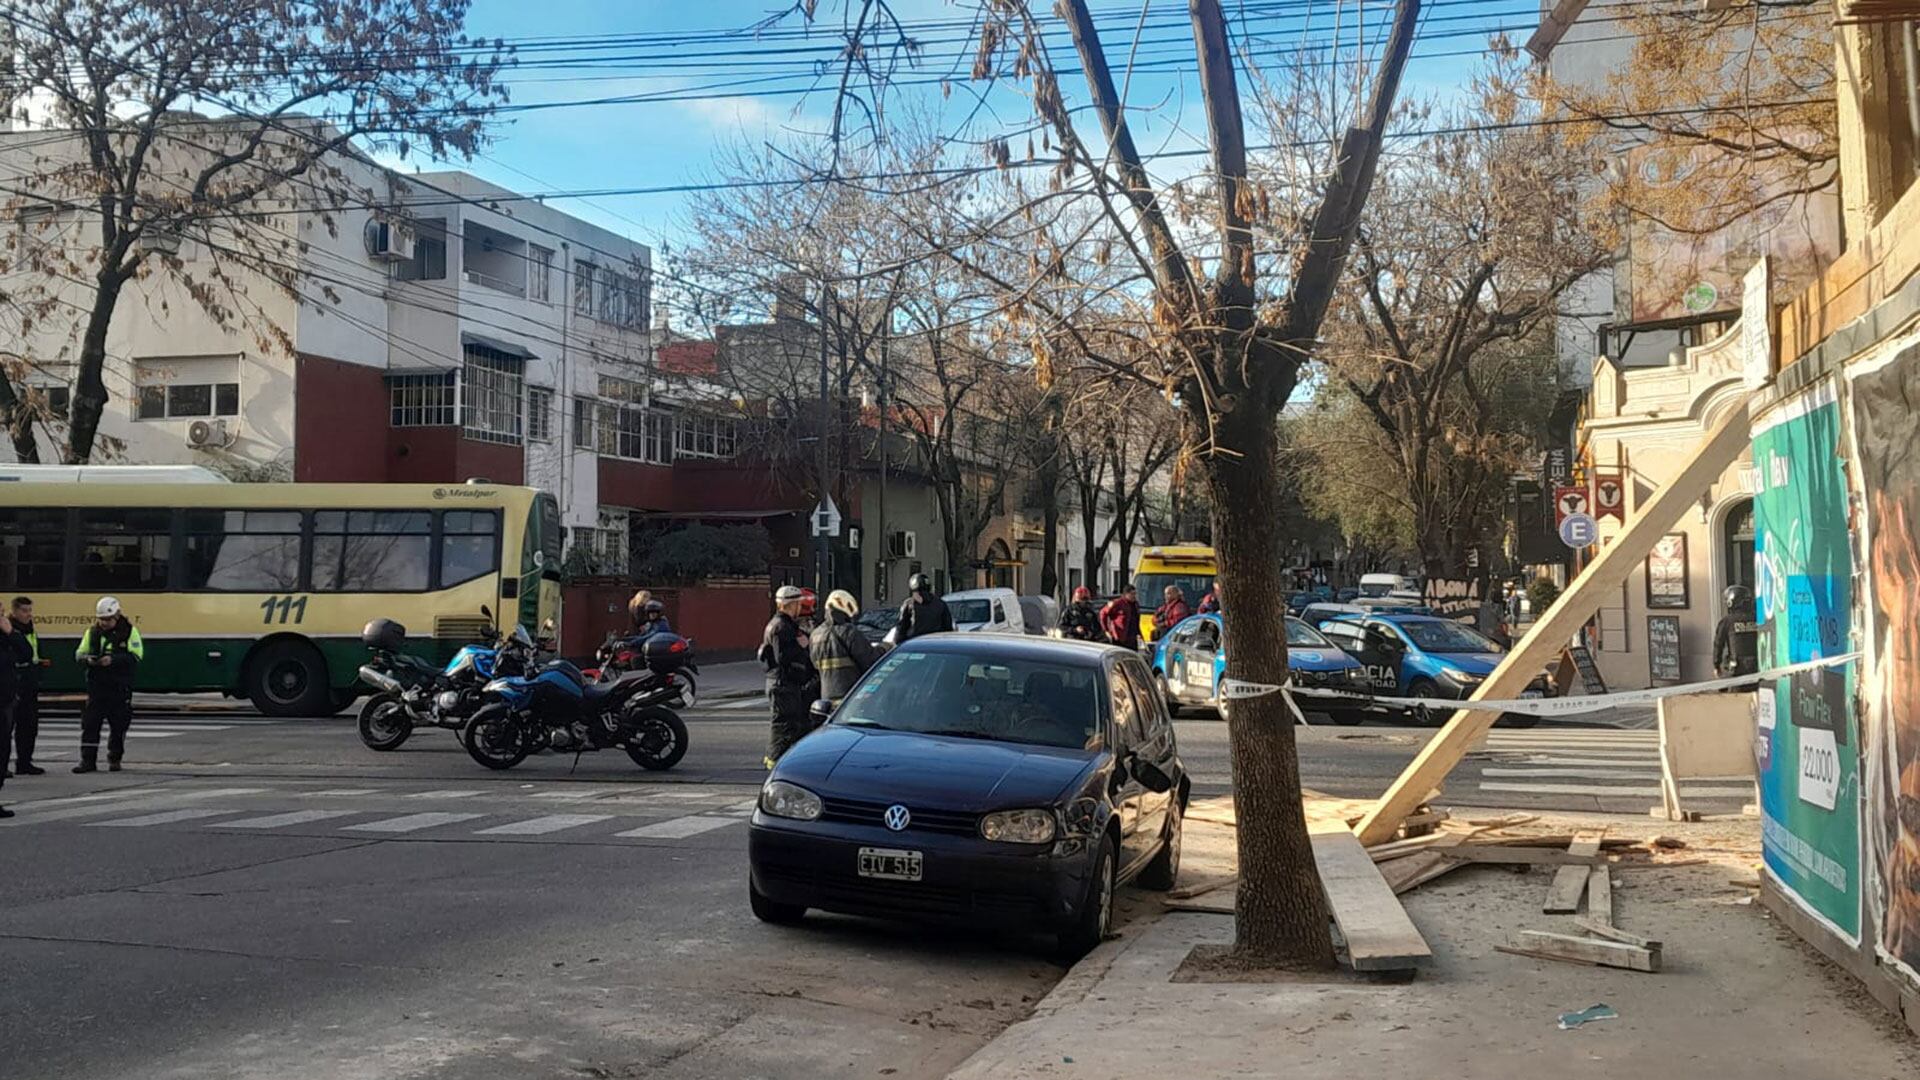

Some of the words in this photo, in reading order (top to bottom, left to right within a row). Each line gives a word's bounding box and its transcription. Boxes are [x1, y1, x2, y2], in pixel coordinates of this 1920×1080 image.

[1571, 522, 1586, 540] E
[261, 595, 308, 624] 111
[894, 857, 920, 875] 515
